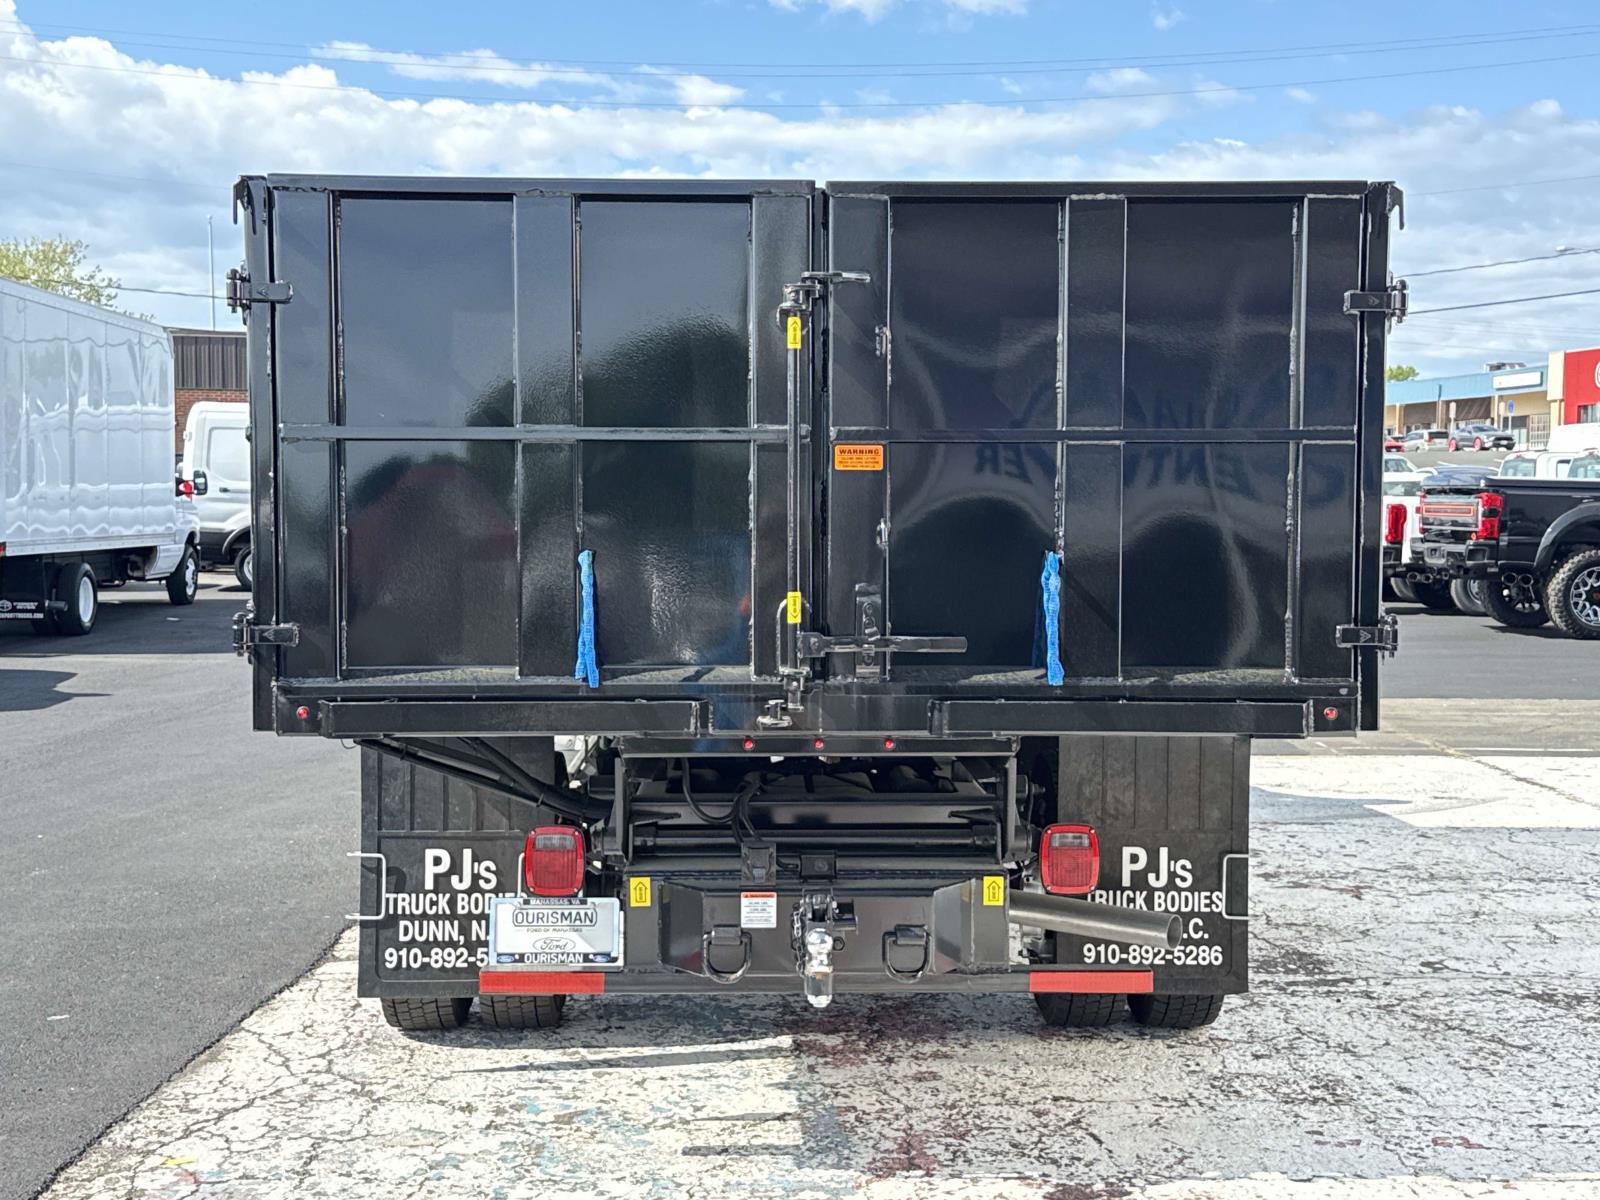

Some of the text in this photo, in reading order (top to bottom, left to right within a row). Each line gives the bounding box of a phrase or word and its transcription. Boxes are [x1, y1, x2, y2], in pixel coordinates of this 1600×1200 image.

[386, 892, 451, 915] TRUCK
[1154, 891, 1223, 913] BODIES
[515, 911, 594, 924] OURISMAN
[398, 920, 465, 946] DUNN,
[540, 939, 569, 951] Ford
[1083, 943, 1223, 966] 910-892-5286
[384, 947, 489, 969] 910-892-5
[524, 953, 584, 963] OURISMAN
